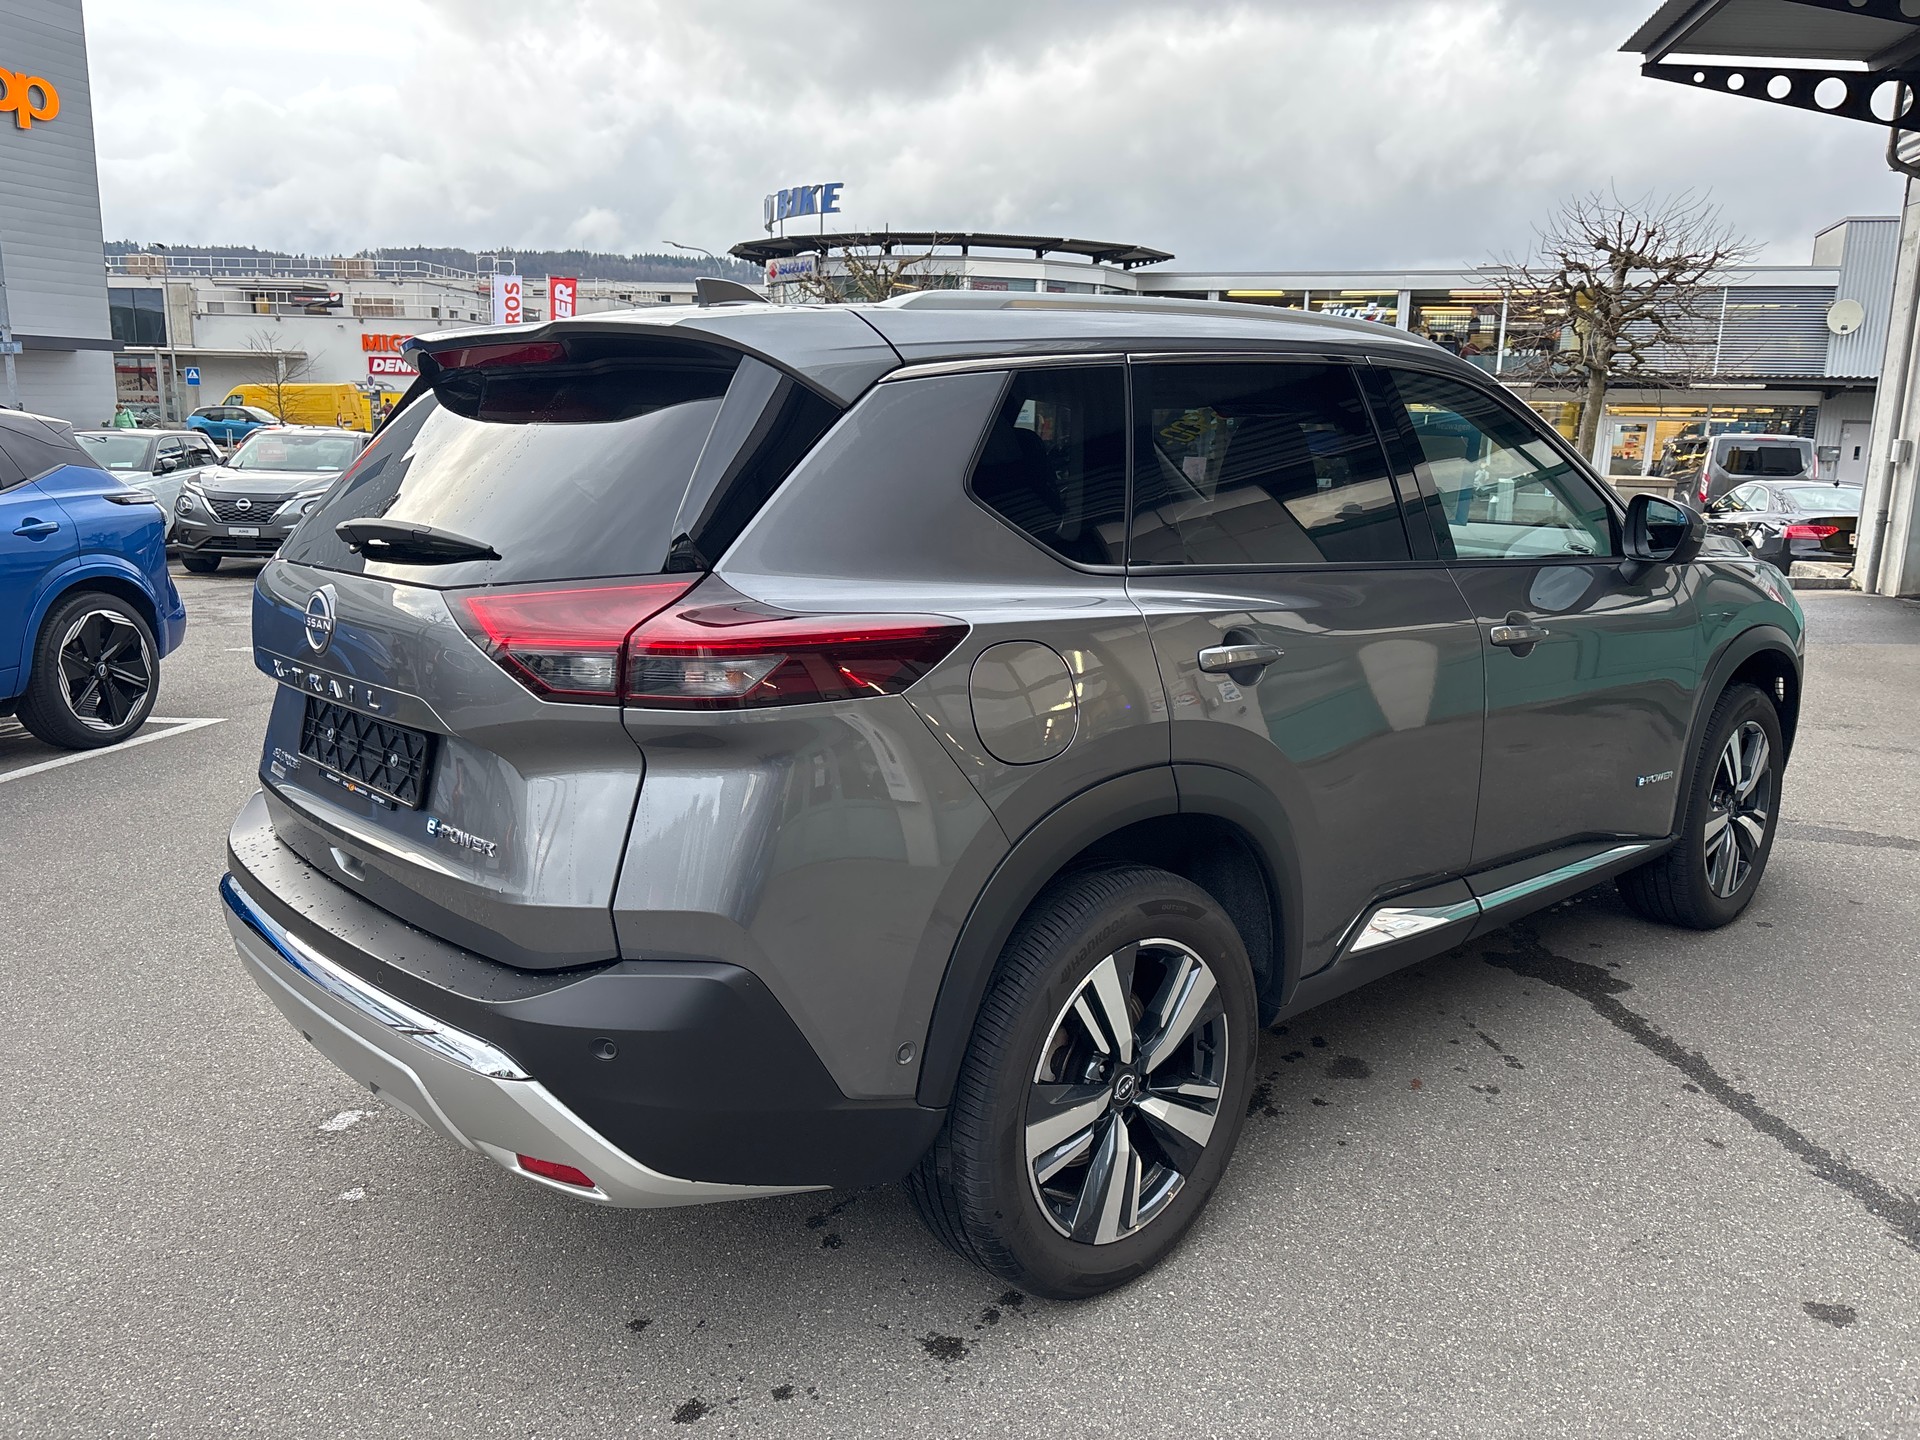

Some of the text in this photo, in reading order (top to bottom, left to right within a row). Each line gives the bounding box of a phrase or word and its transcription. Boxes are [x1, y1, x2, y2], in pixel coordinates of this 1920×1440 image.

[777, 183, 844, 220] BIKE
[504, 282, 520, 323] ROS
[554, 283, 573, 321] ER
[361, 334, 412, 352] MIG
[273, 659, 382, 710] X-TRAIL
[426, 817, 498, 858] e-POWER
